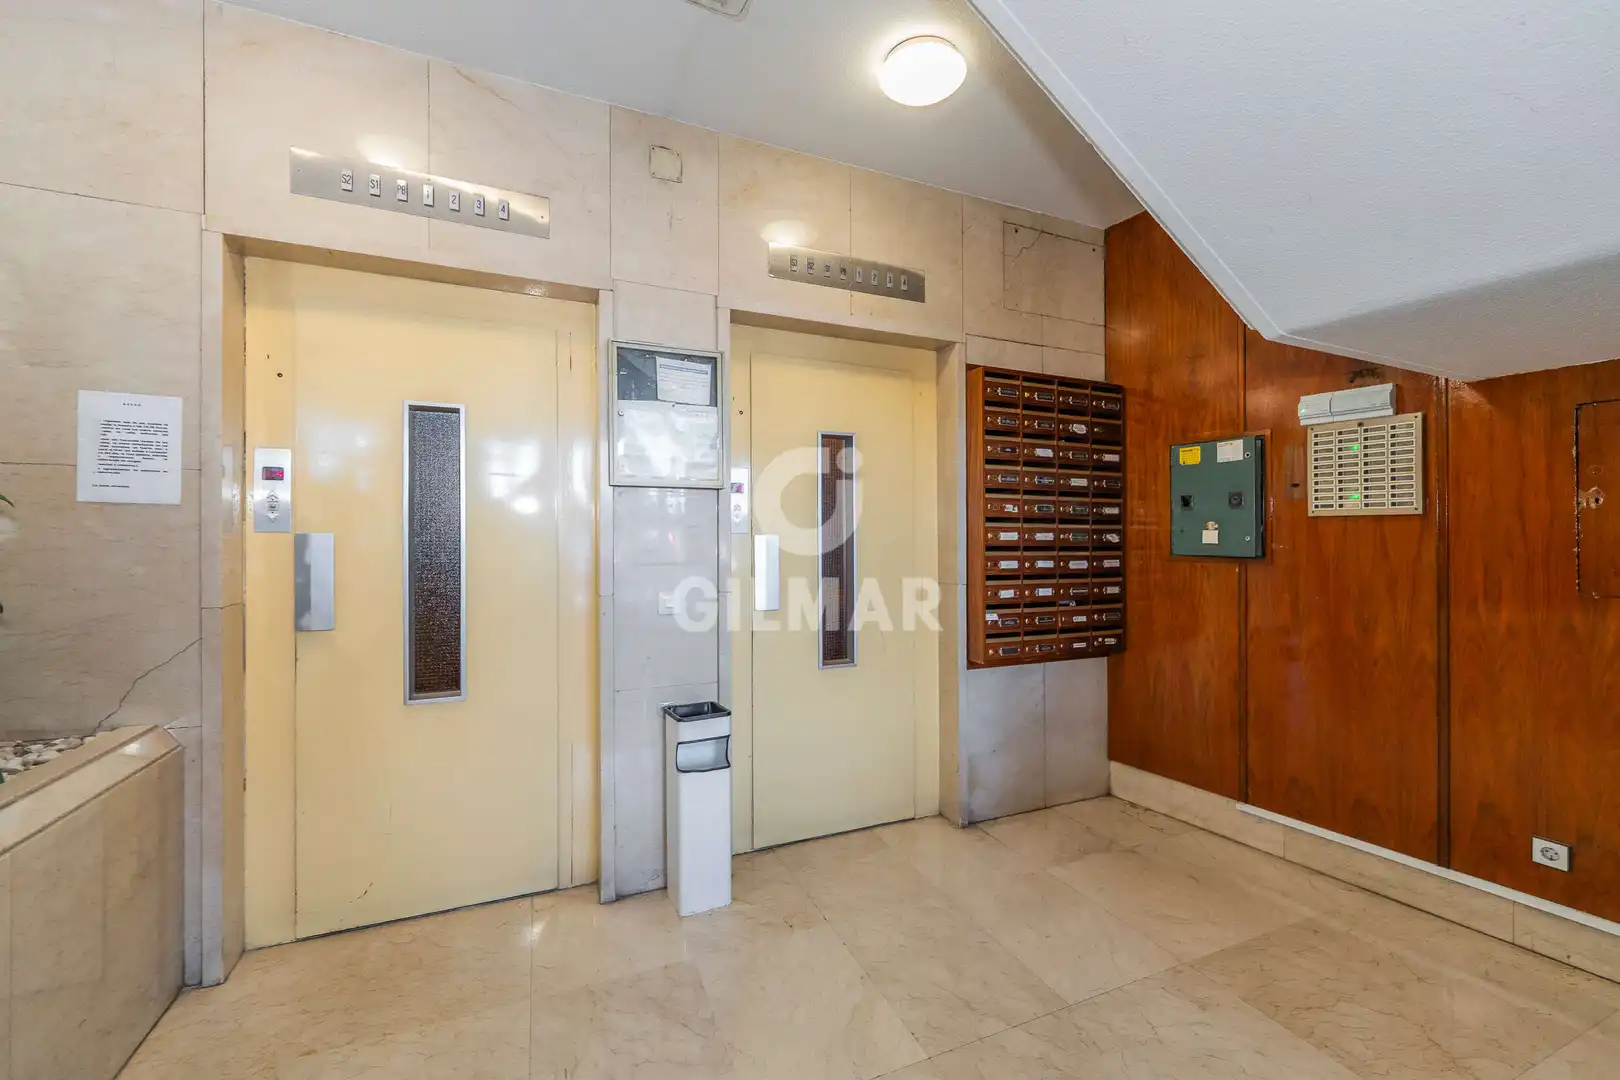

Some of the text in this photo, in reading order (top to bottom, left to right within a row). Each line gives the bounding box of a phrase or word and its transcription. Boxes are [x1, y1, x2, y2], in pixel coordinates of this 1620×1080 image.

[341, 173, 352, 185] S2
[369, 179, 379, 190] S1
[451, 194, 457, 205] 2
[476, 199, 482, 209] 3
